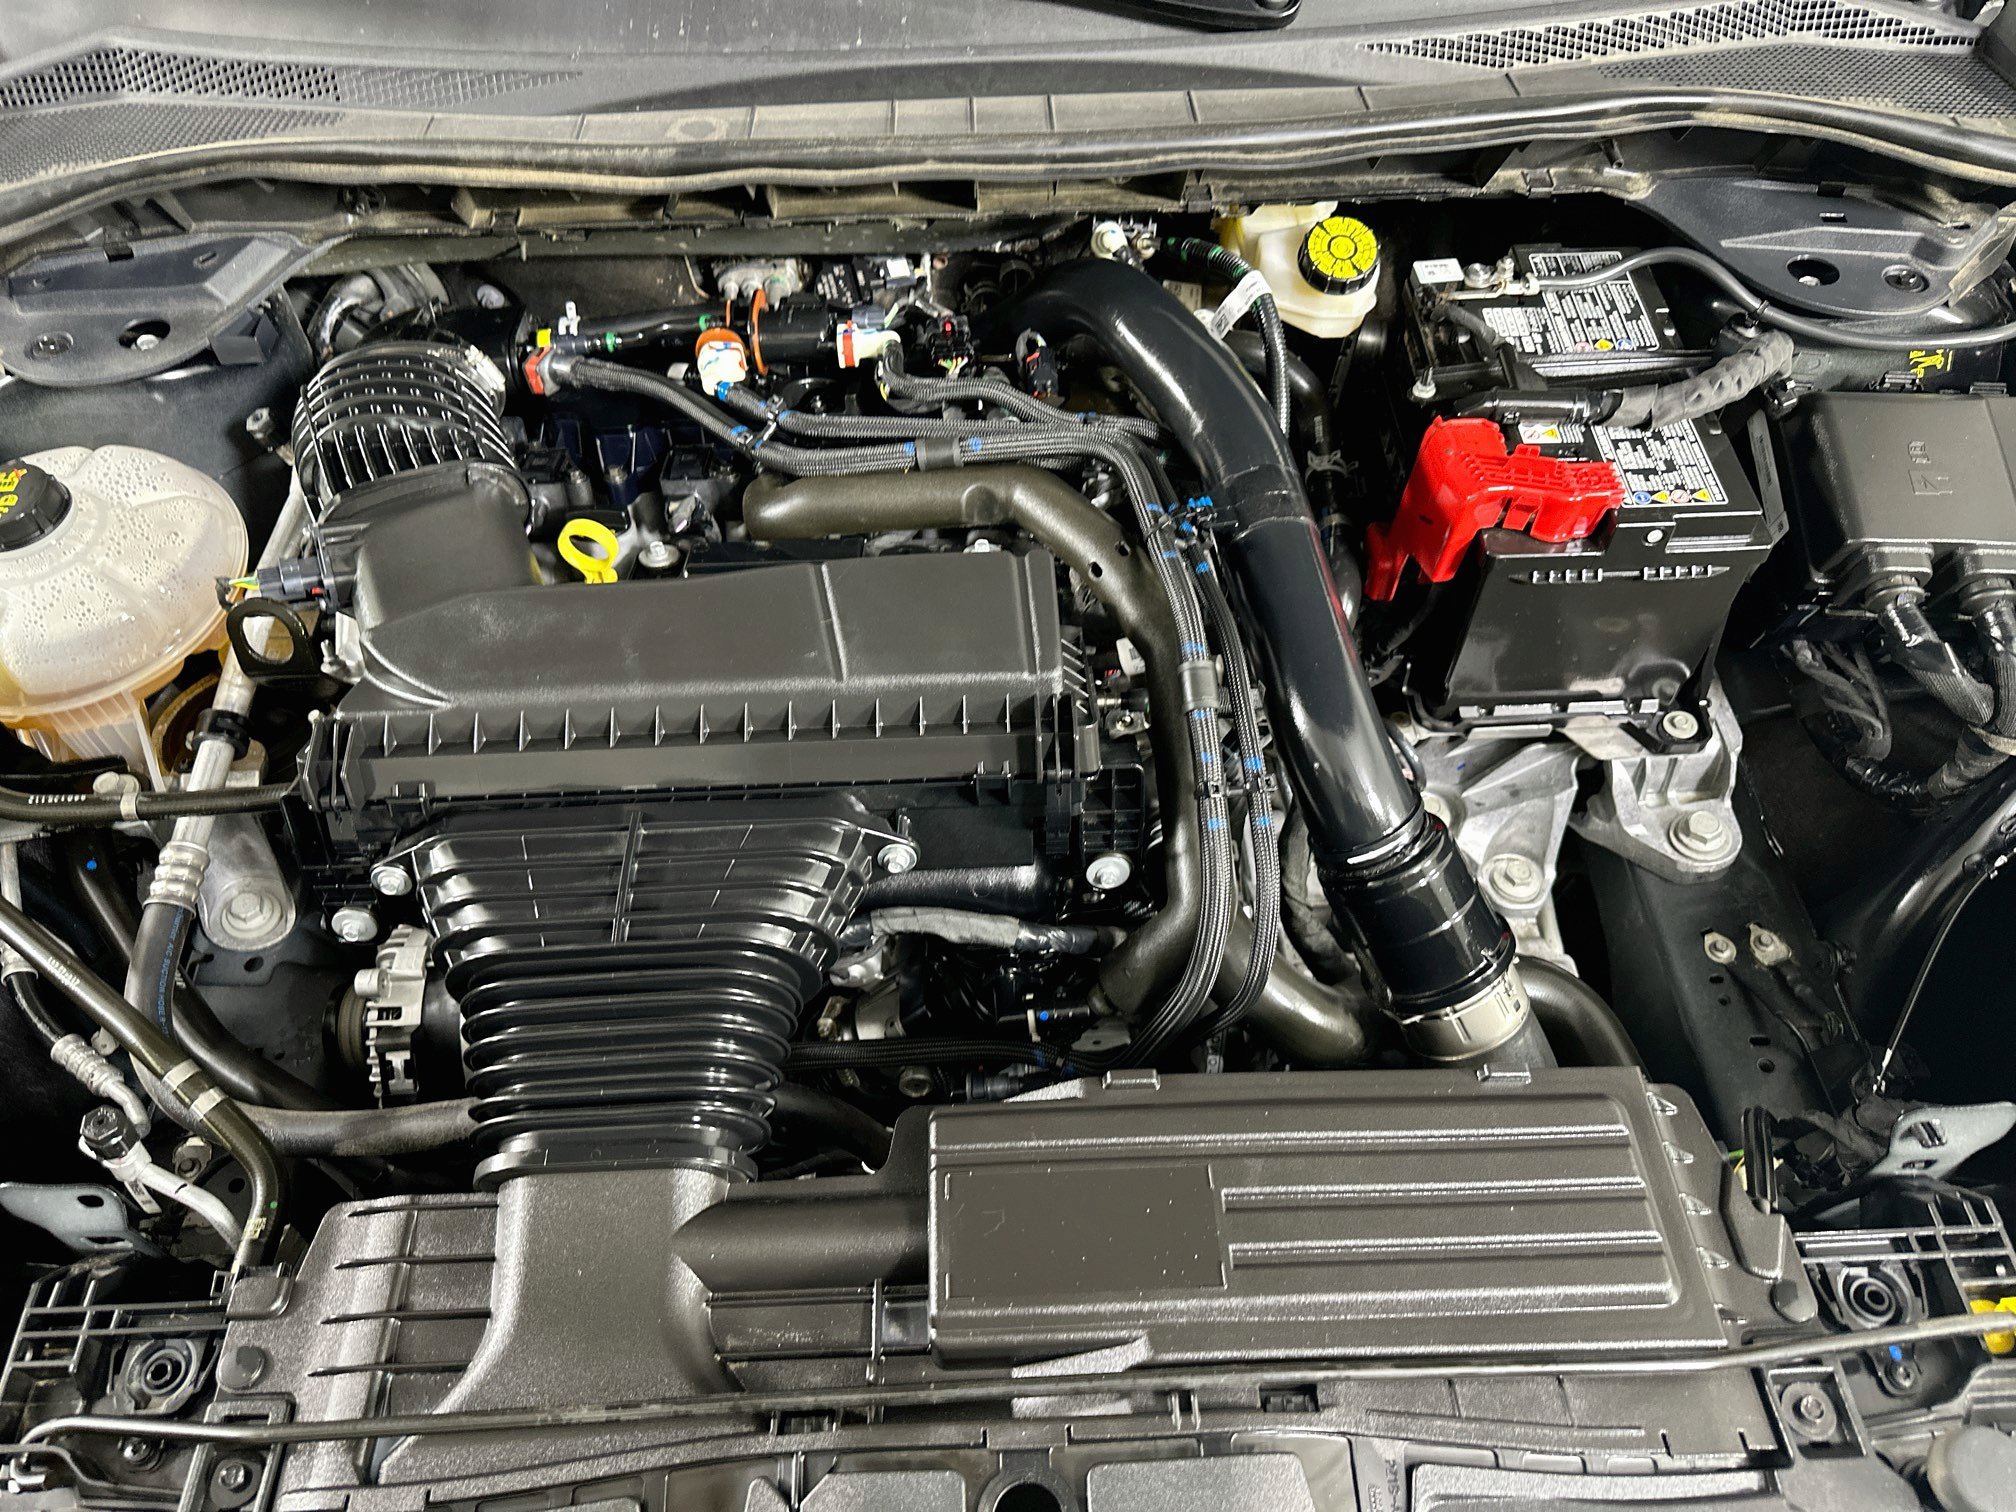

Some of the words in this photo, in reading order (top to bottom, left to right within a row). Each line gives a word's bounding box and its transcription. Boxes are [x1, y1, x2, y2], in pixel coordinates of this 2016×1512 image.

[165, 942, 175, 957] A/C
[159, 958, 171, 993] SUCTION
[157, 994, 167, 1016] HOSE
